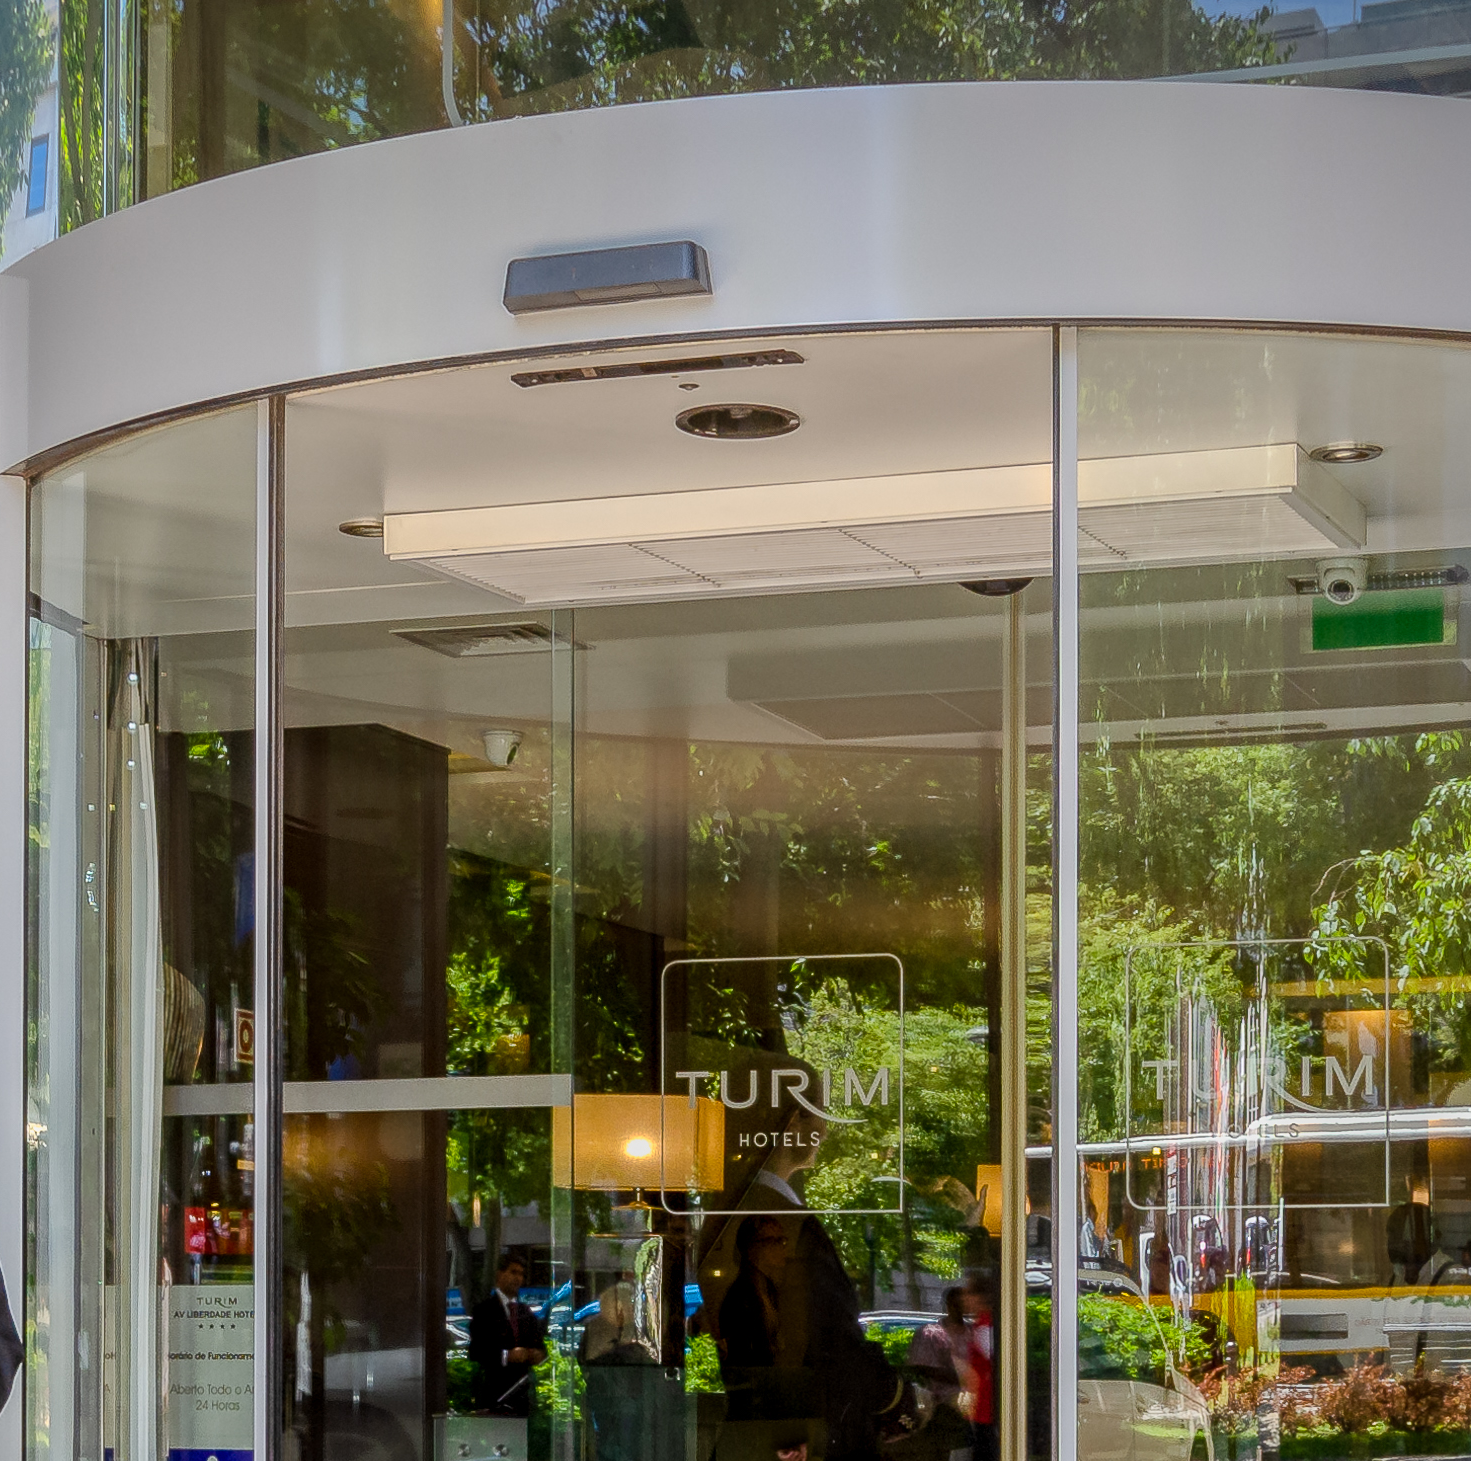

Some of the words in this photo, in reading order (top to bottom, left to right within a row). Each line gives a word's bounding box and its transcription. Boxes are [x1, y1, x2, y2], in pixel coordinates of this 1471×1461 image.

[675, 1066, 889, 1124] TURIM
[739, 1131, 821, 1147] HOTELS
[196, 1297, 238, 1309] TURIM
[173, 1310, 185, 1319] AV
[186, 1310, 232, 1319] LIBERDADE
[233, 1310, 254, 1319] HOTE
[168, 1351, 193, 1360] orário
[194, 1351, 206, 1360] de
[170, 1383, 205, 1395] Aberto
[206, 1383, 232, 1395] Todo
[234, 1386, 242, 1395] o
[195, 1400, 209, 1411] 24
[211, 1400, 241, 1411] Horas
